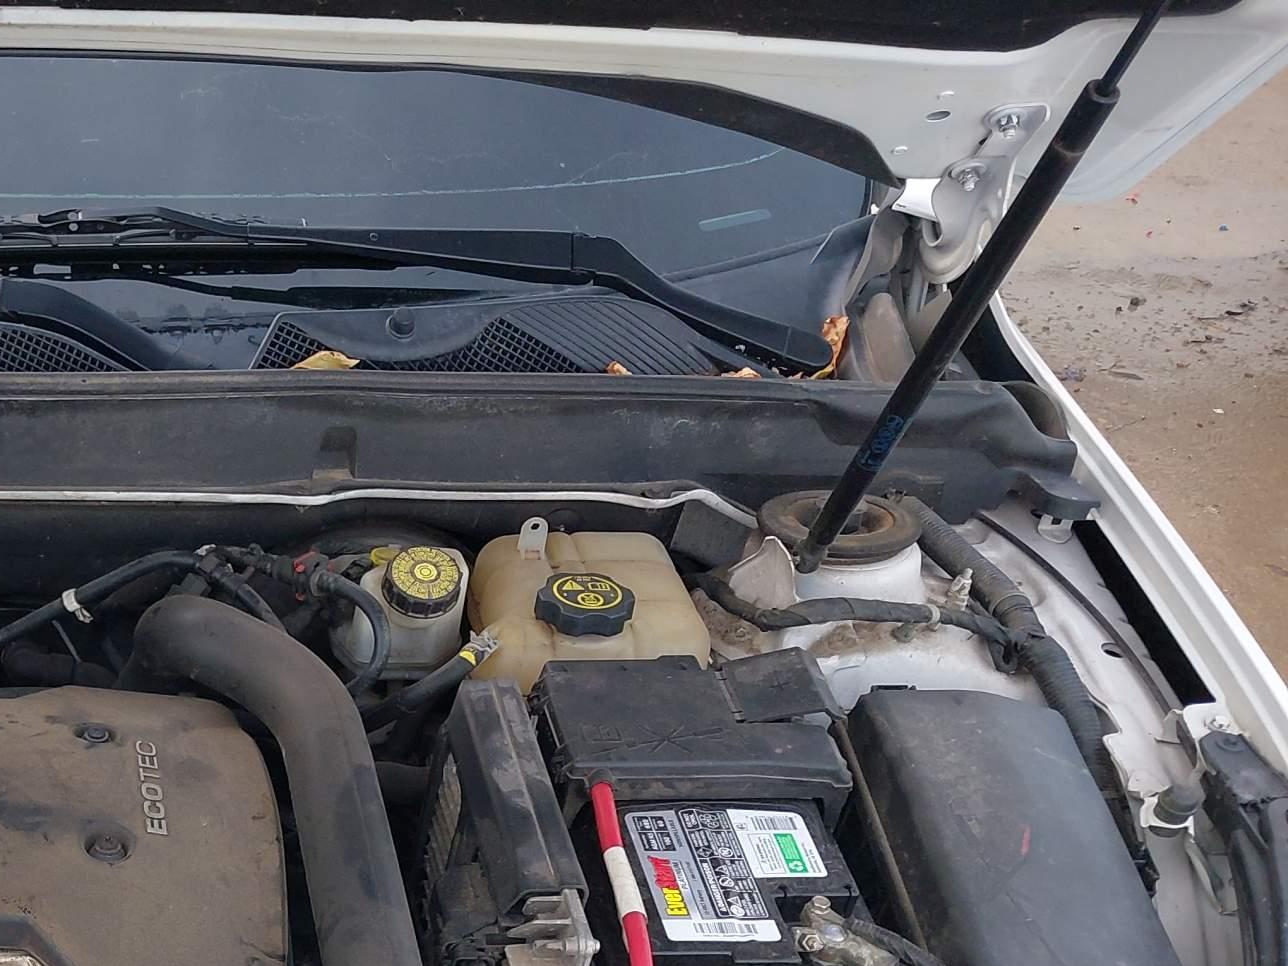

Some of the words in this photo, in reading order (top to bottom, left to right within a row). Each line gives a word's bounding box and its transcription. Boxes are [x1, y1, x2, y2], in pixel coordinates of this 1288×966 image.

[135, 740, 169, 836] ECOTEC
[647, 855, 690, 916] EverStart
[672, 861, 689, 890] PLATINUM
